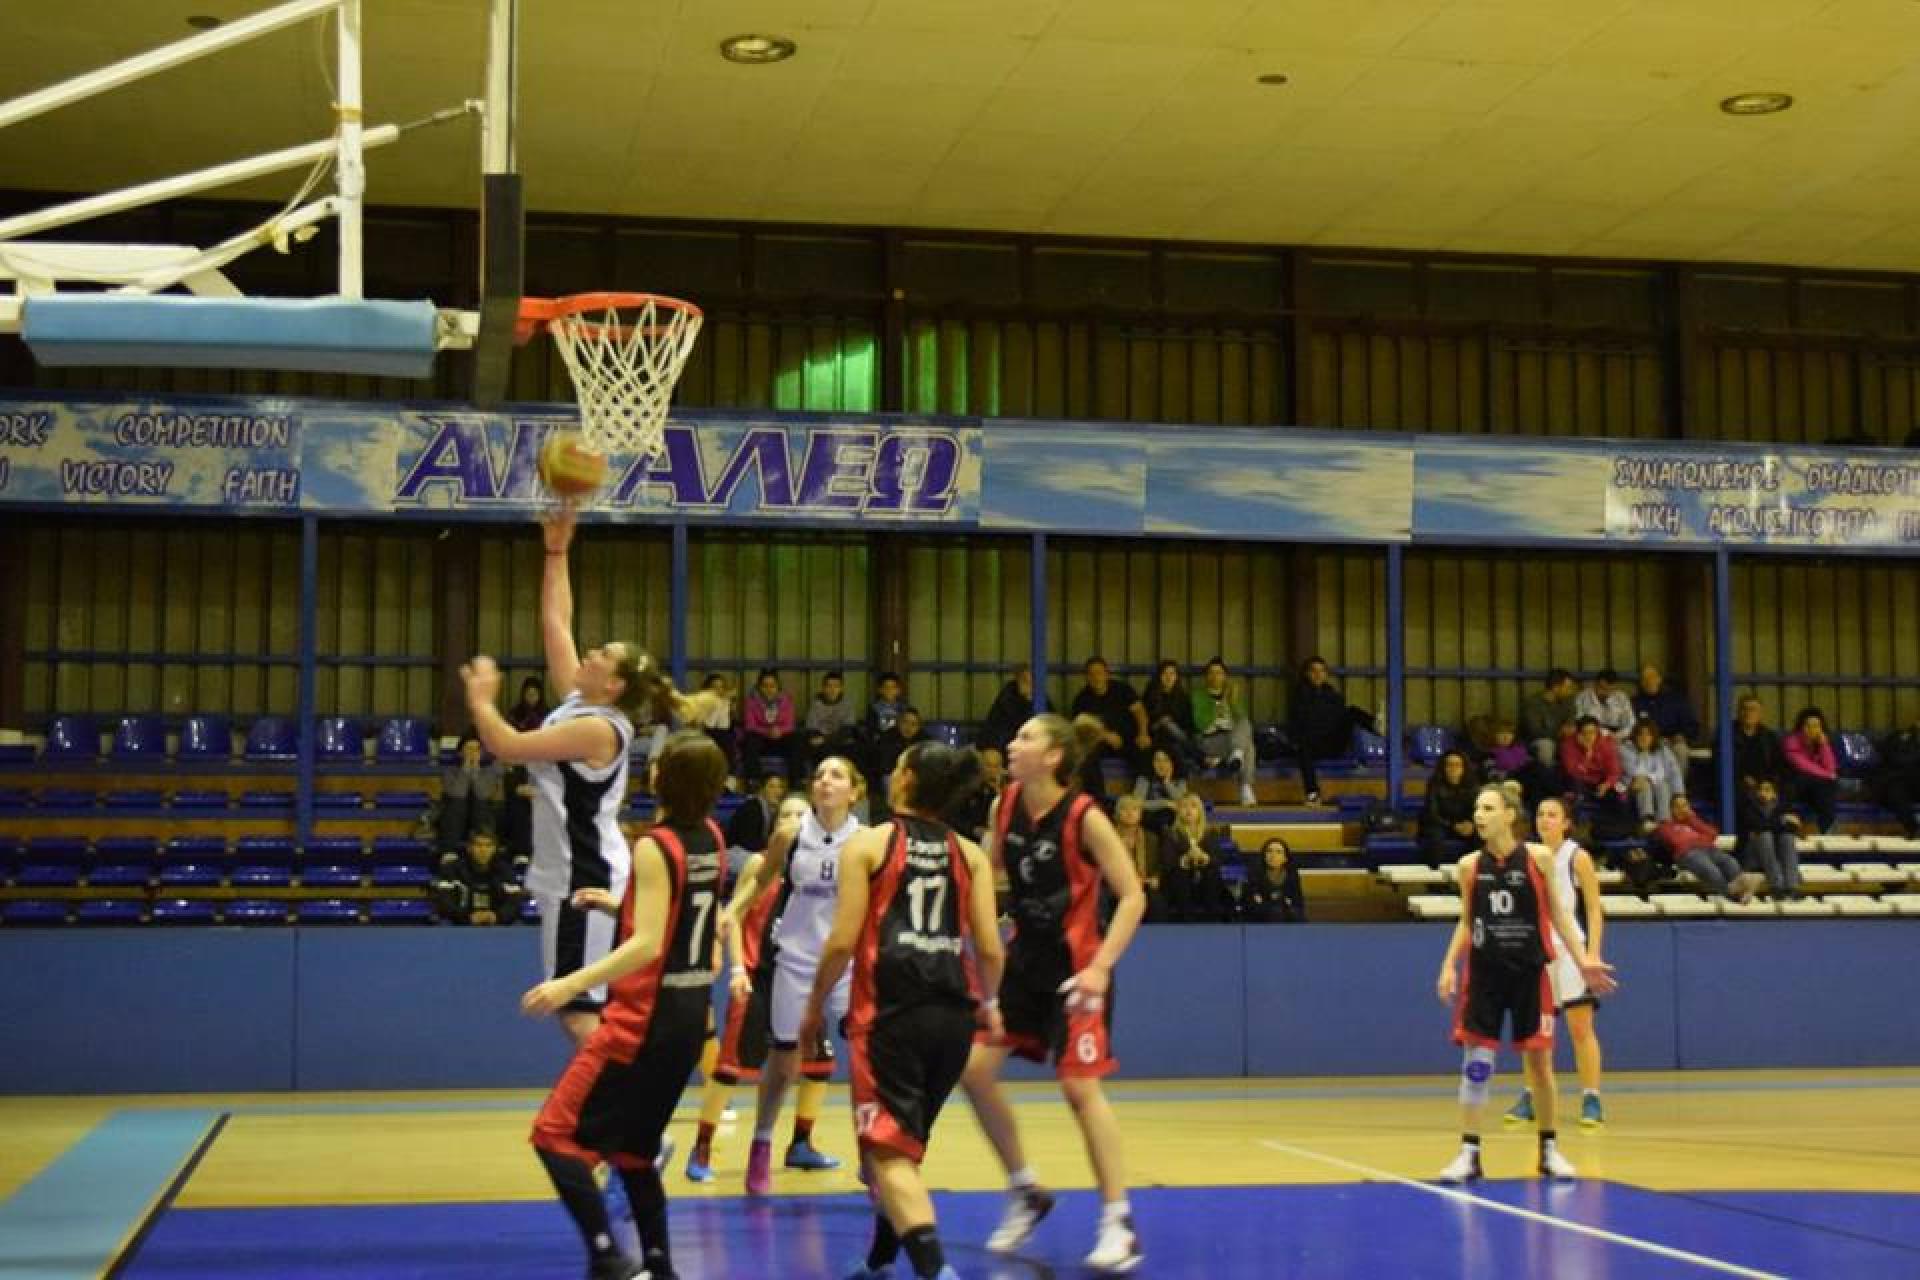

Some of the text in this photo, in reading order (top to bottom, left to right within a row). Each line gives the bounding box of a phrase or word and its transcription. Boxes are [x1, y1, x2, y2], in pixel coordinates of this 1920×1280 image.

[113, 412, 290, 448] COMPETITION
[62, 459, 298, 503] VICTORY FAITH
[394, 412, 961, 515] ΑΙΑΛΕΩ
[907, 875, 948, 932] 17
[1488, 889, 1514, 914] 10
[689, 891, 714, 965] 7
[1077, 1032, 1098, 1064] 6
